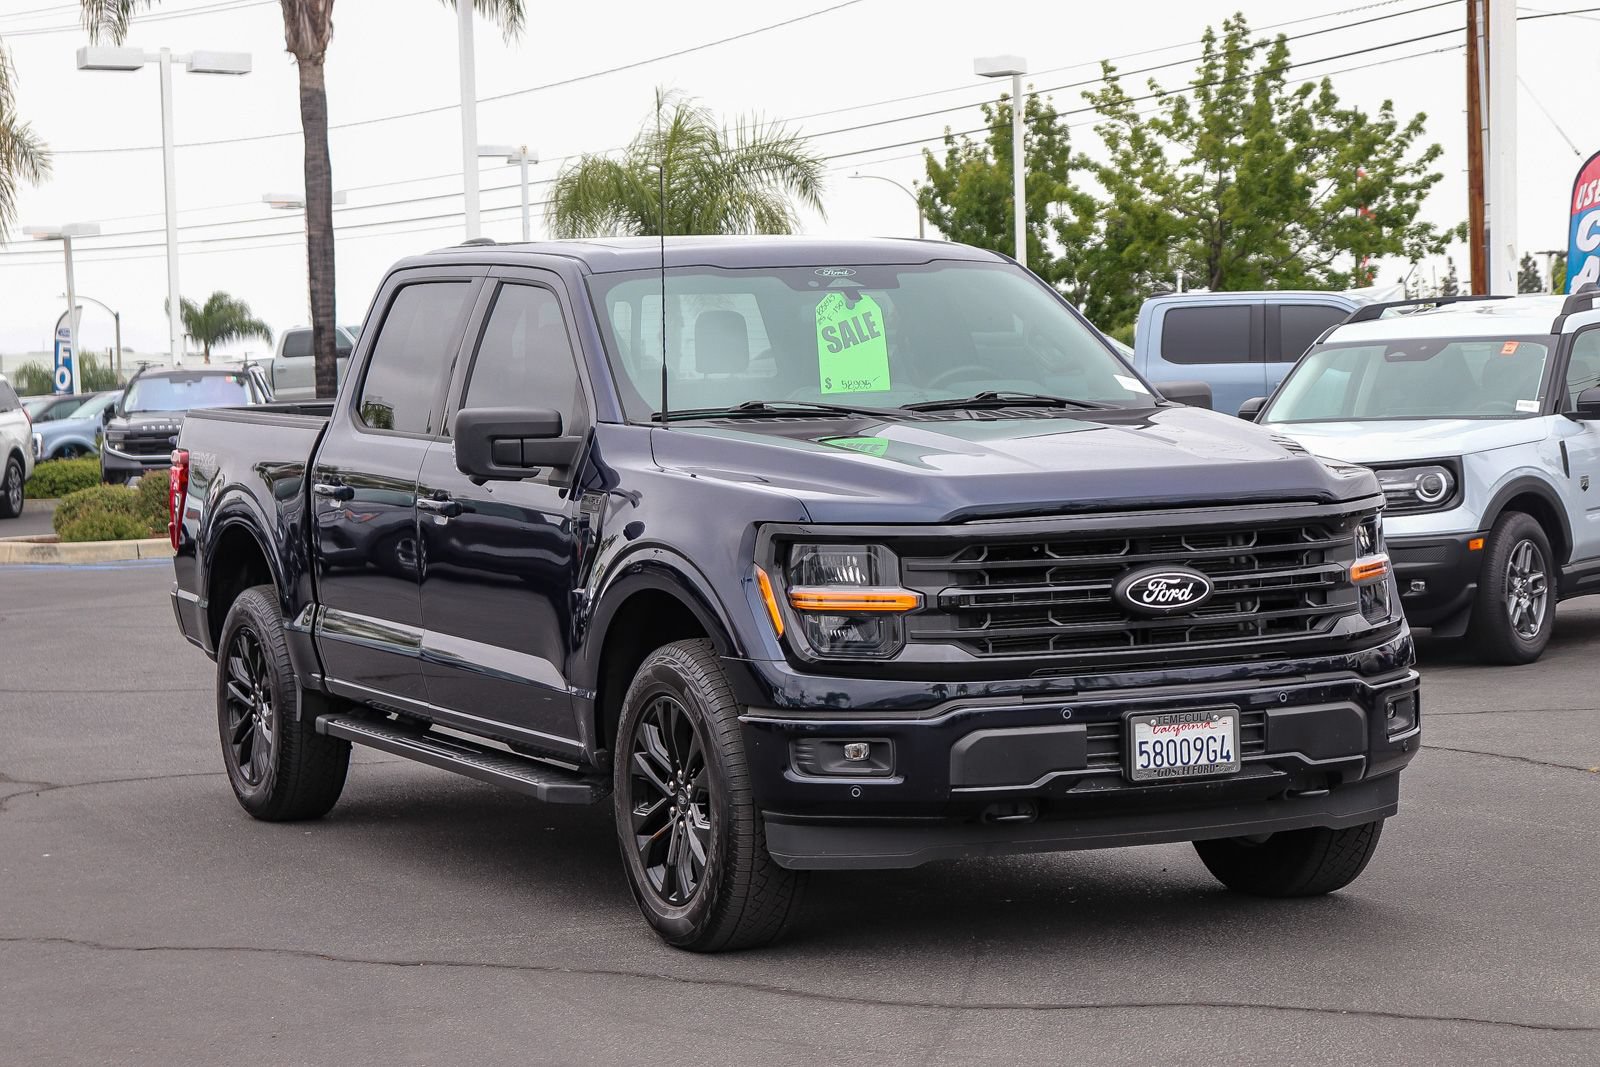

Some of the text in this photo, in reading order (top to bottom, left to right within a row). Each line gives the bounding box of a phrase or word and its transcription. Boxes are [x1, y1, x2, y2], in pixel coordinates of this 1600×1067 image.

[821, 311, 881, 353] SALE
[1143, 579, 1194, 603] Ford
[1157, 712, 1212, 724] TEMECULA
[1152, 722, 1217, 736] California
[1138, 735, 1231, 768] 58009G4
[1192, 764, 1215, 774] FORD
